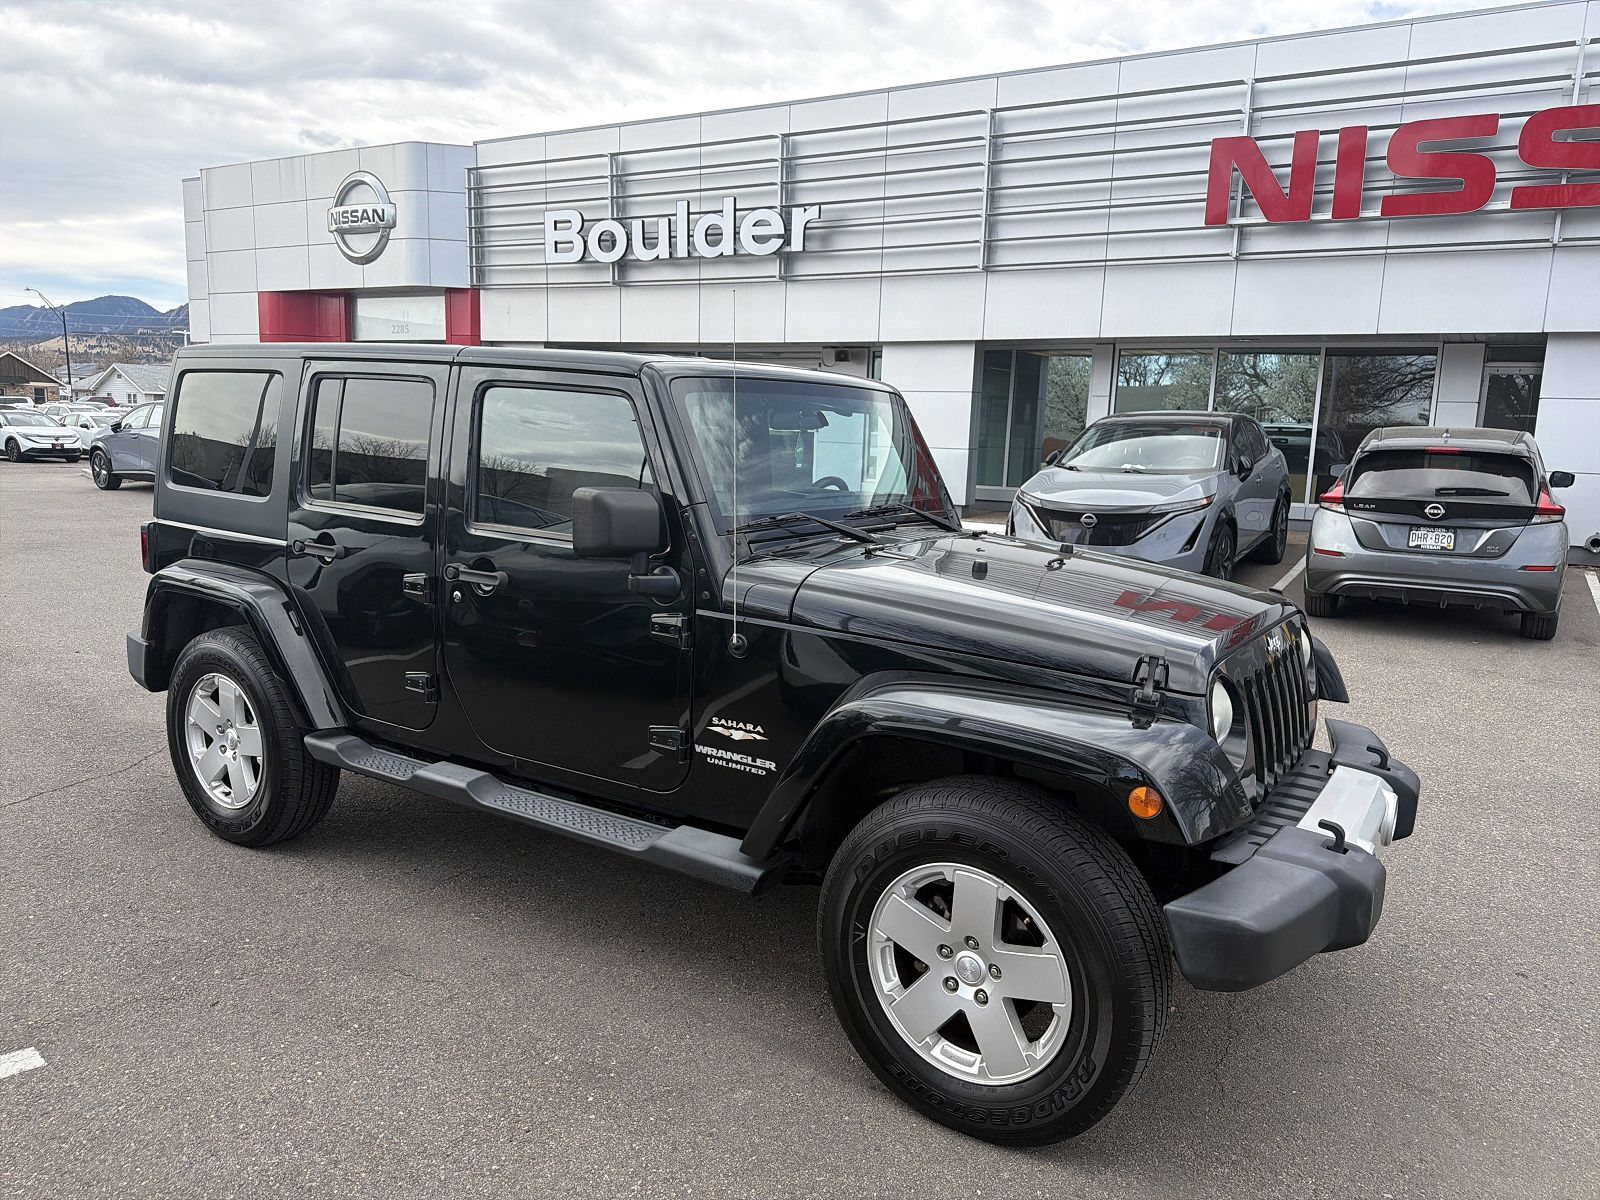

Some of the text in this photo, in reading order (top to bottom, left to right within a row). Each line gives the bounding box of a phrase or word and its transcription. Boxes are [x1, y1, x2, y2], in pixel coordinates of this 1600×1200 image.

[330, 208, 385, 226] NISSAN
[544, 196, 821, 263] Boulder
[391, 324, 409, 334] 2285
[711, 717, 764, 733] SAHARA
[694, 744, 777, 772] WRANGLER
[706, 757, 767, 776] UNLIMITED
